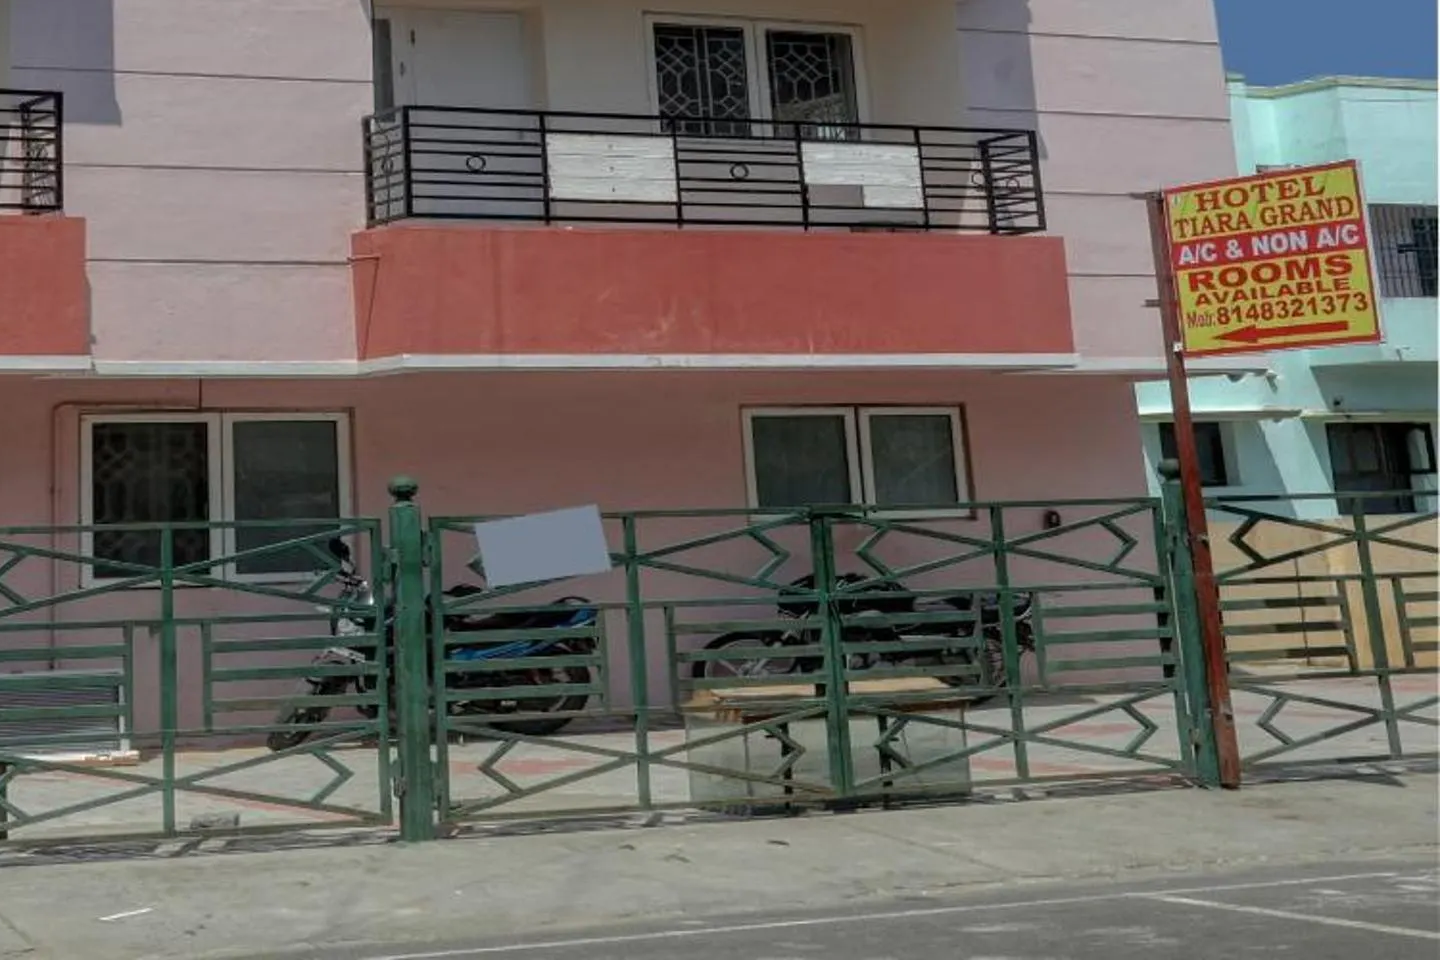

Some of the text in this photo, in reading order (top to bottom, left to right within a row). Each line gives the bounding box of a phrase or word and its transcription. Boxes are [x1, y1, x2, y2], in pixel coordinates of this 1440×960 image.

[1195, 175, 1325, 213] HOTEL
[1174, 196, 1354, 239] TIARA GRAND
[1179, 224, 1360, 265] A/C & NON A/C
[1189, 254, 1353, 292] ROOMS
[1195, 278, 1351, 307] AVAILABLE
[1216, 292, 1368, 326] 8148321373
